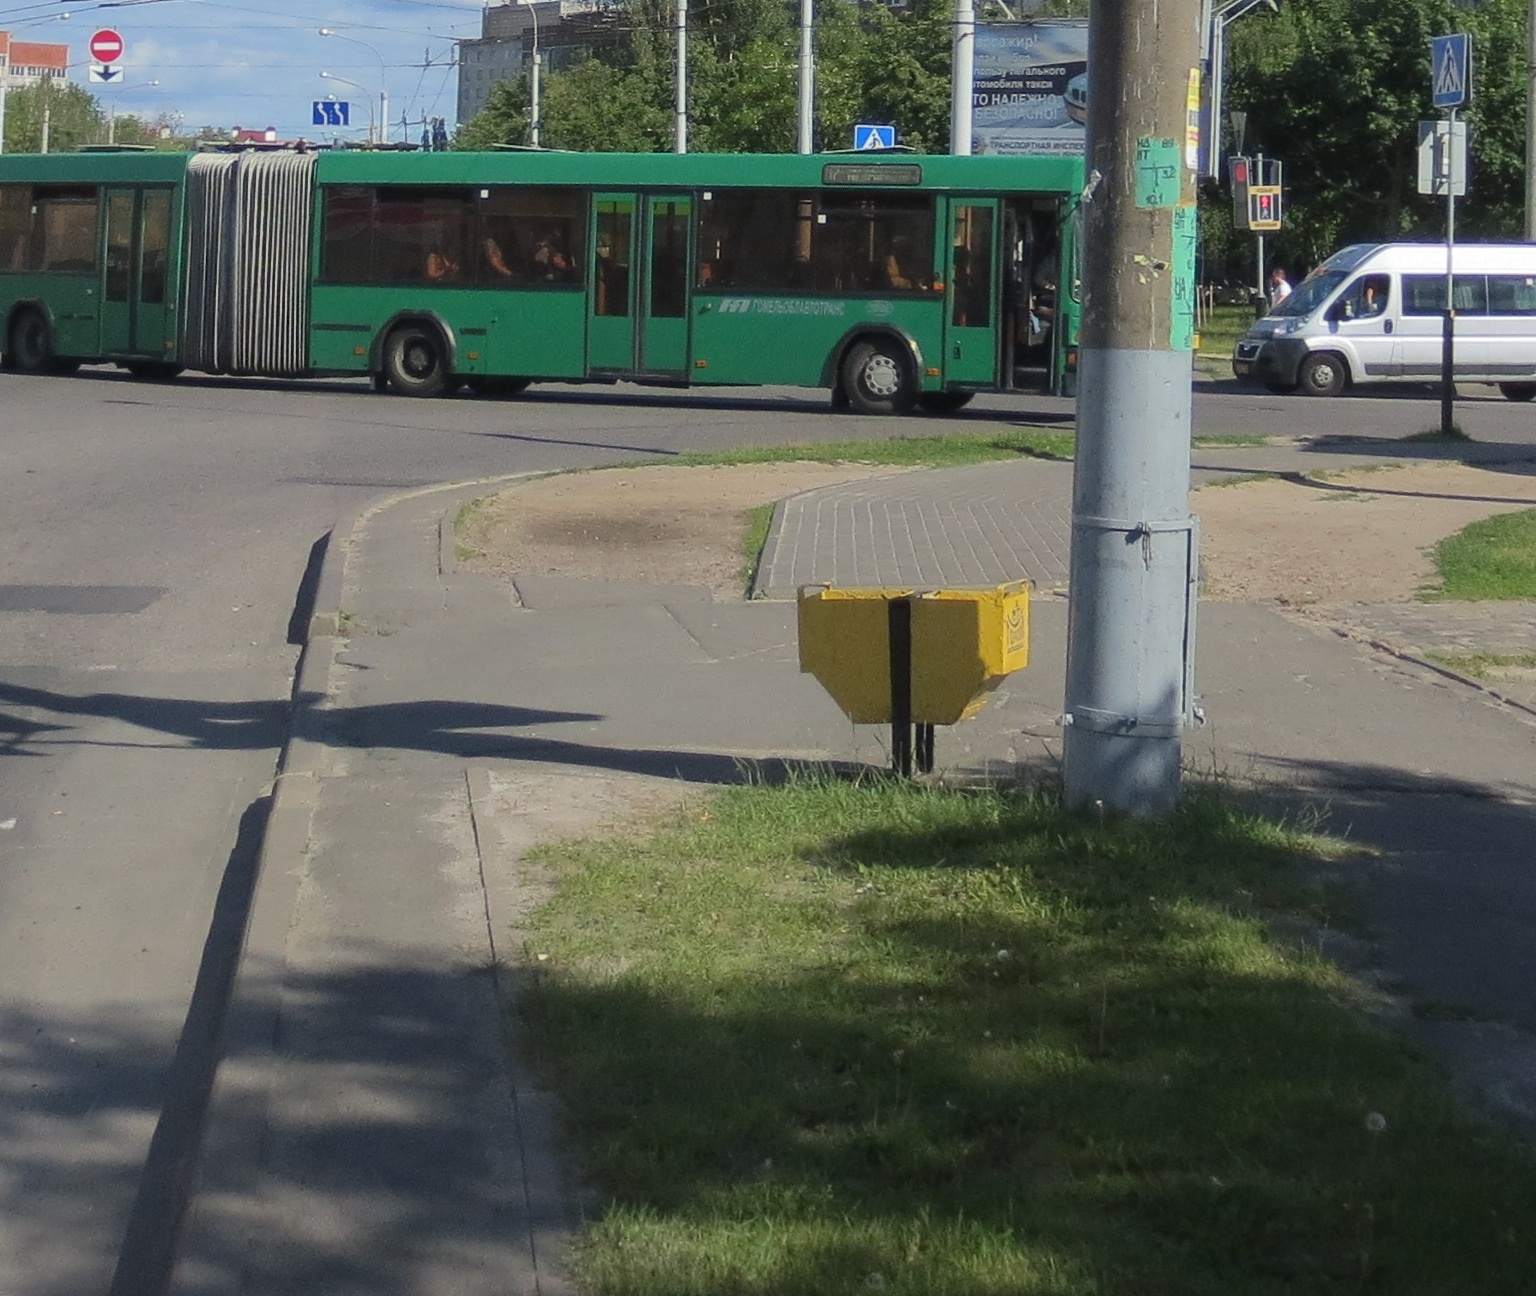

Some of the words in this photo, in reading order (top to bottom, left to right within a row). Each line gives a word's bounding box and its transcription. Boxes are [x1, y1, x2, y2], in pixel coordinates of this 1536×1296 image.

[974, 34, 1038, 49] ассажир!
[973, 78, 1023, 88] томобиля
[973, 93, 989, 105] ТО
